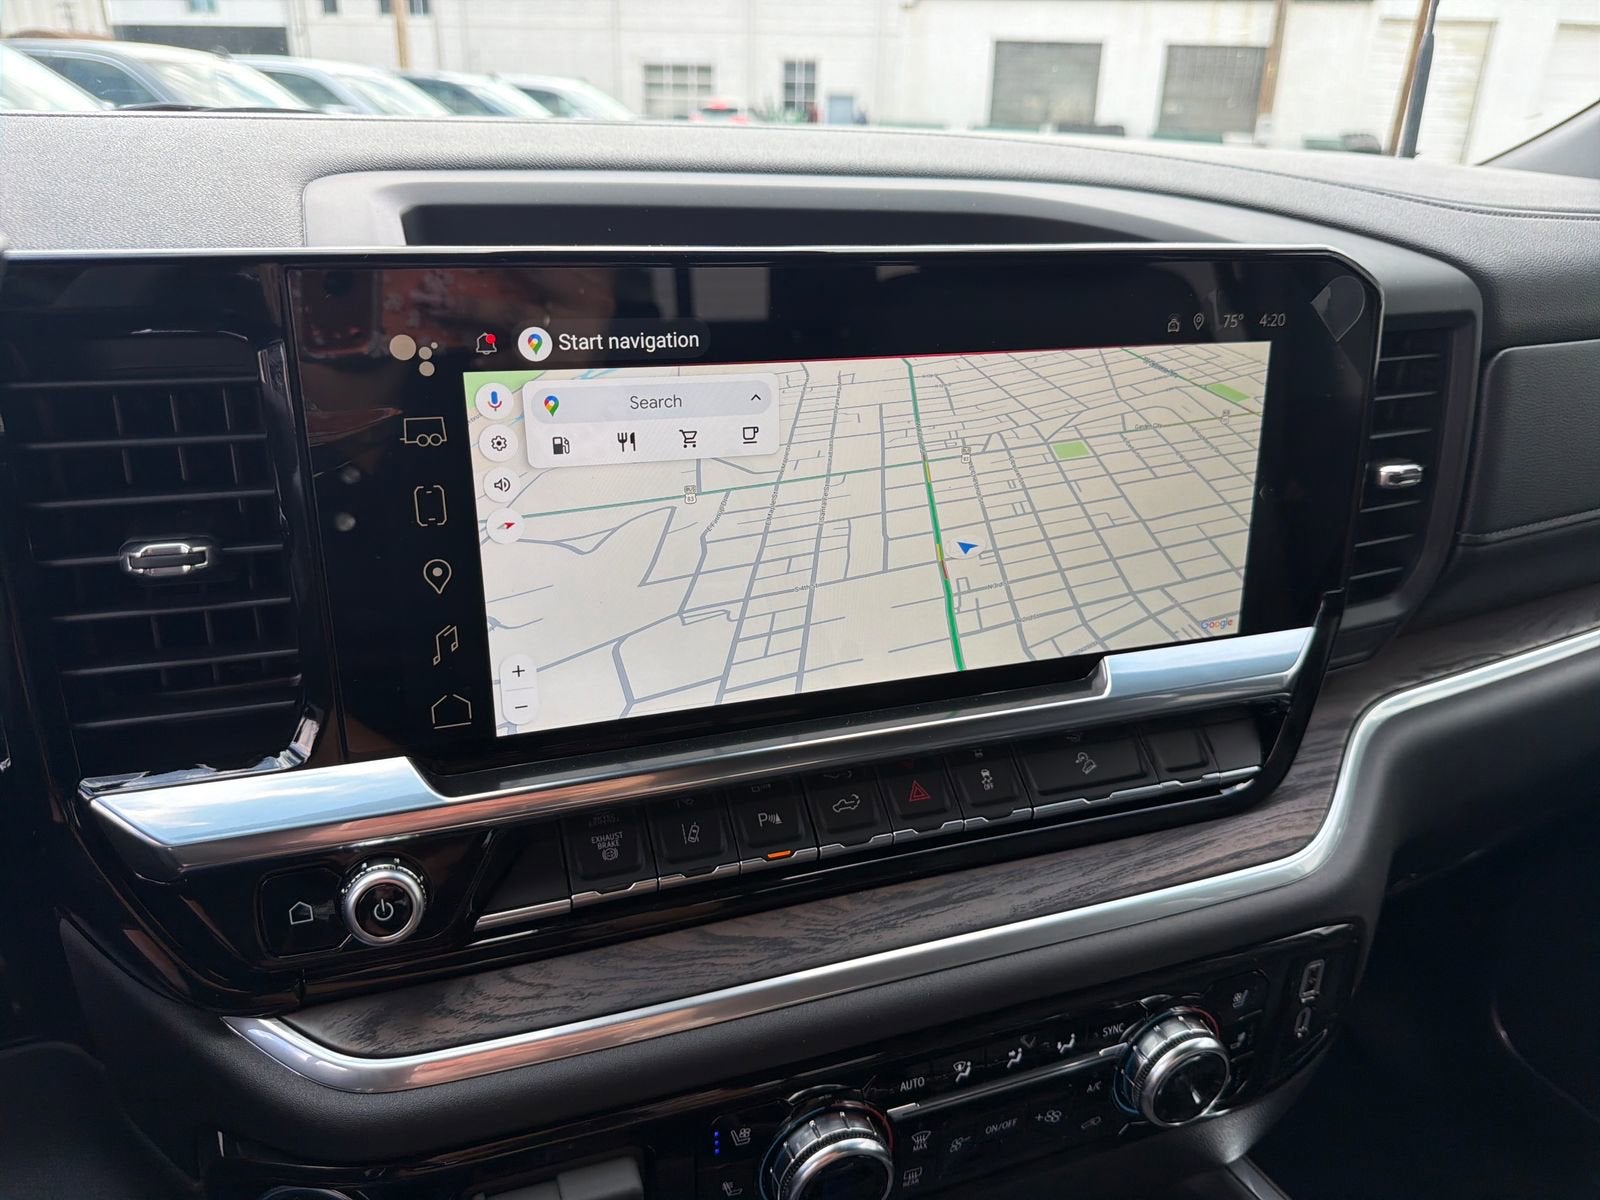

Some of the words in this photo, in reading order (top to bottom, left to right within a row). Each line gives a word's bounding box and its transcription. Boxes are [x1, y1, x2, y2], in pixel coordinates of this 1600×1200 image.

[1259, 313, 1286, 327] 4:20
[558, 333, 604, 351] Start
[609, 331, 700, 353] navigation
[629, 394, 683, 410] Search
[1200, 617, 1233, 630] Google
[758, 812, 769, 827] P
[591, 831, 623, 844] EXHAUST
[597, 840, 620, 849] BRAKE
[1102, 1022, 1125, 1038] SYNC
[900, 1076, 925, 1092] AUTO
[985, 1118, 1017, 1135] ON/OFF
